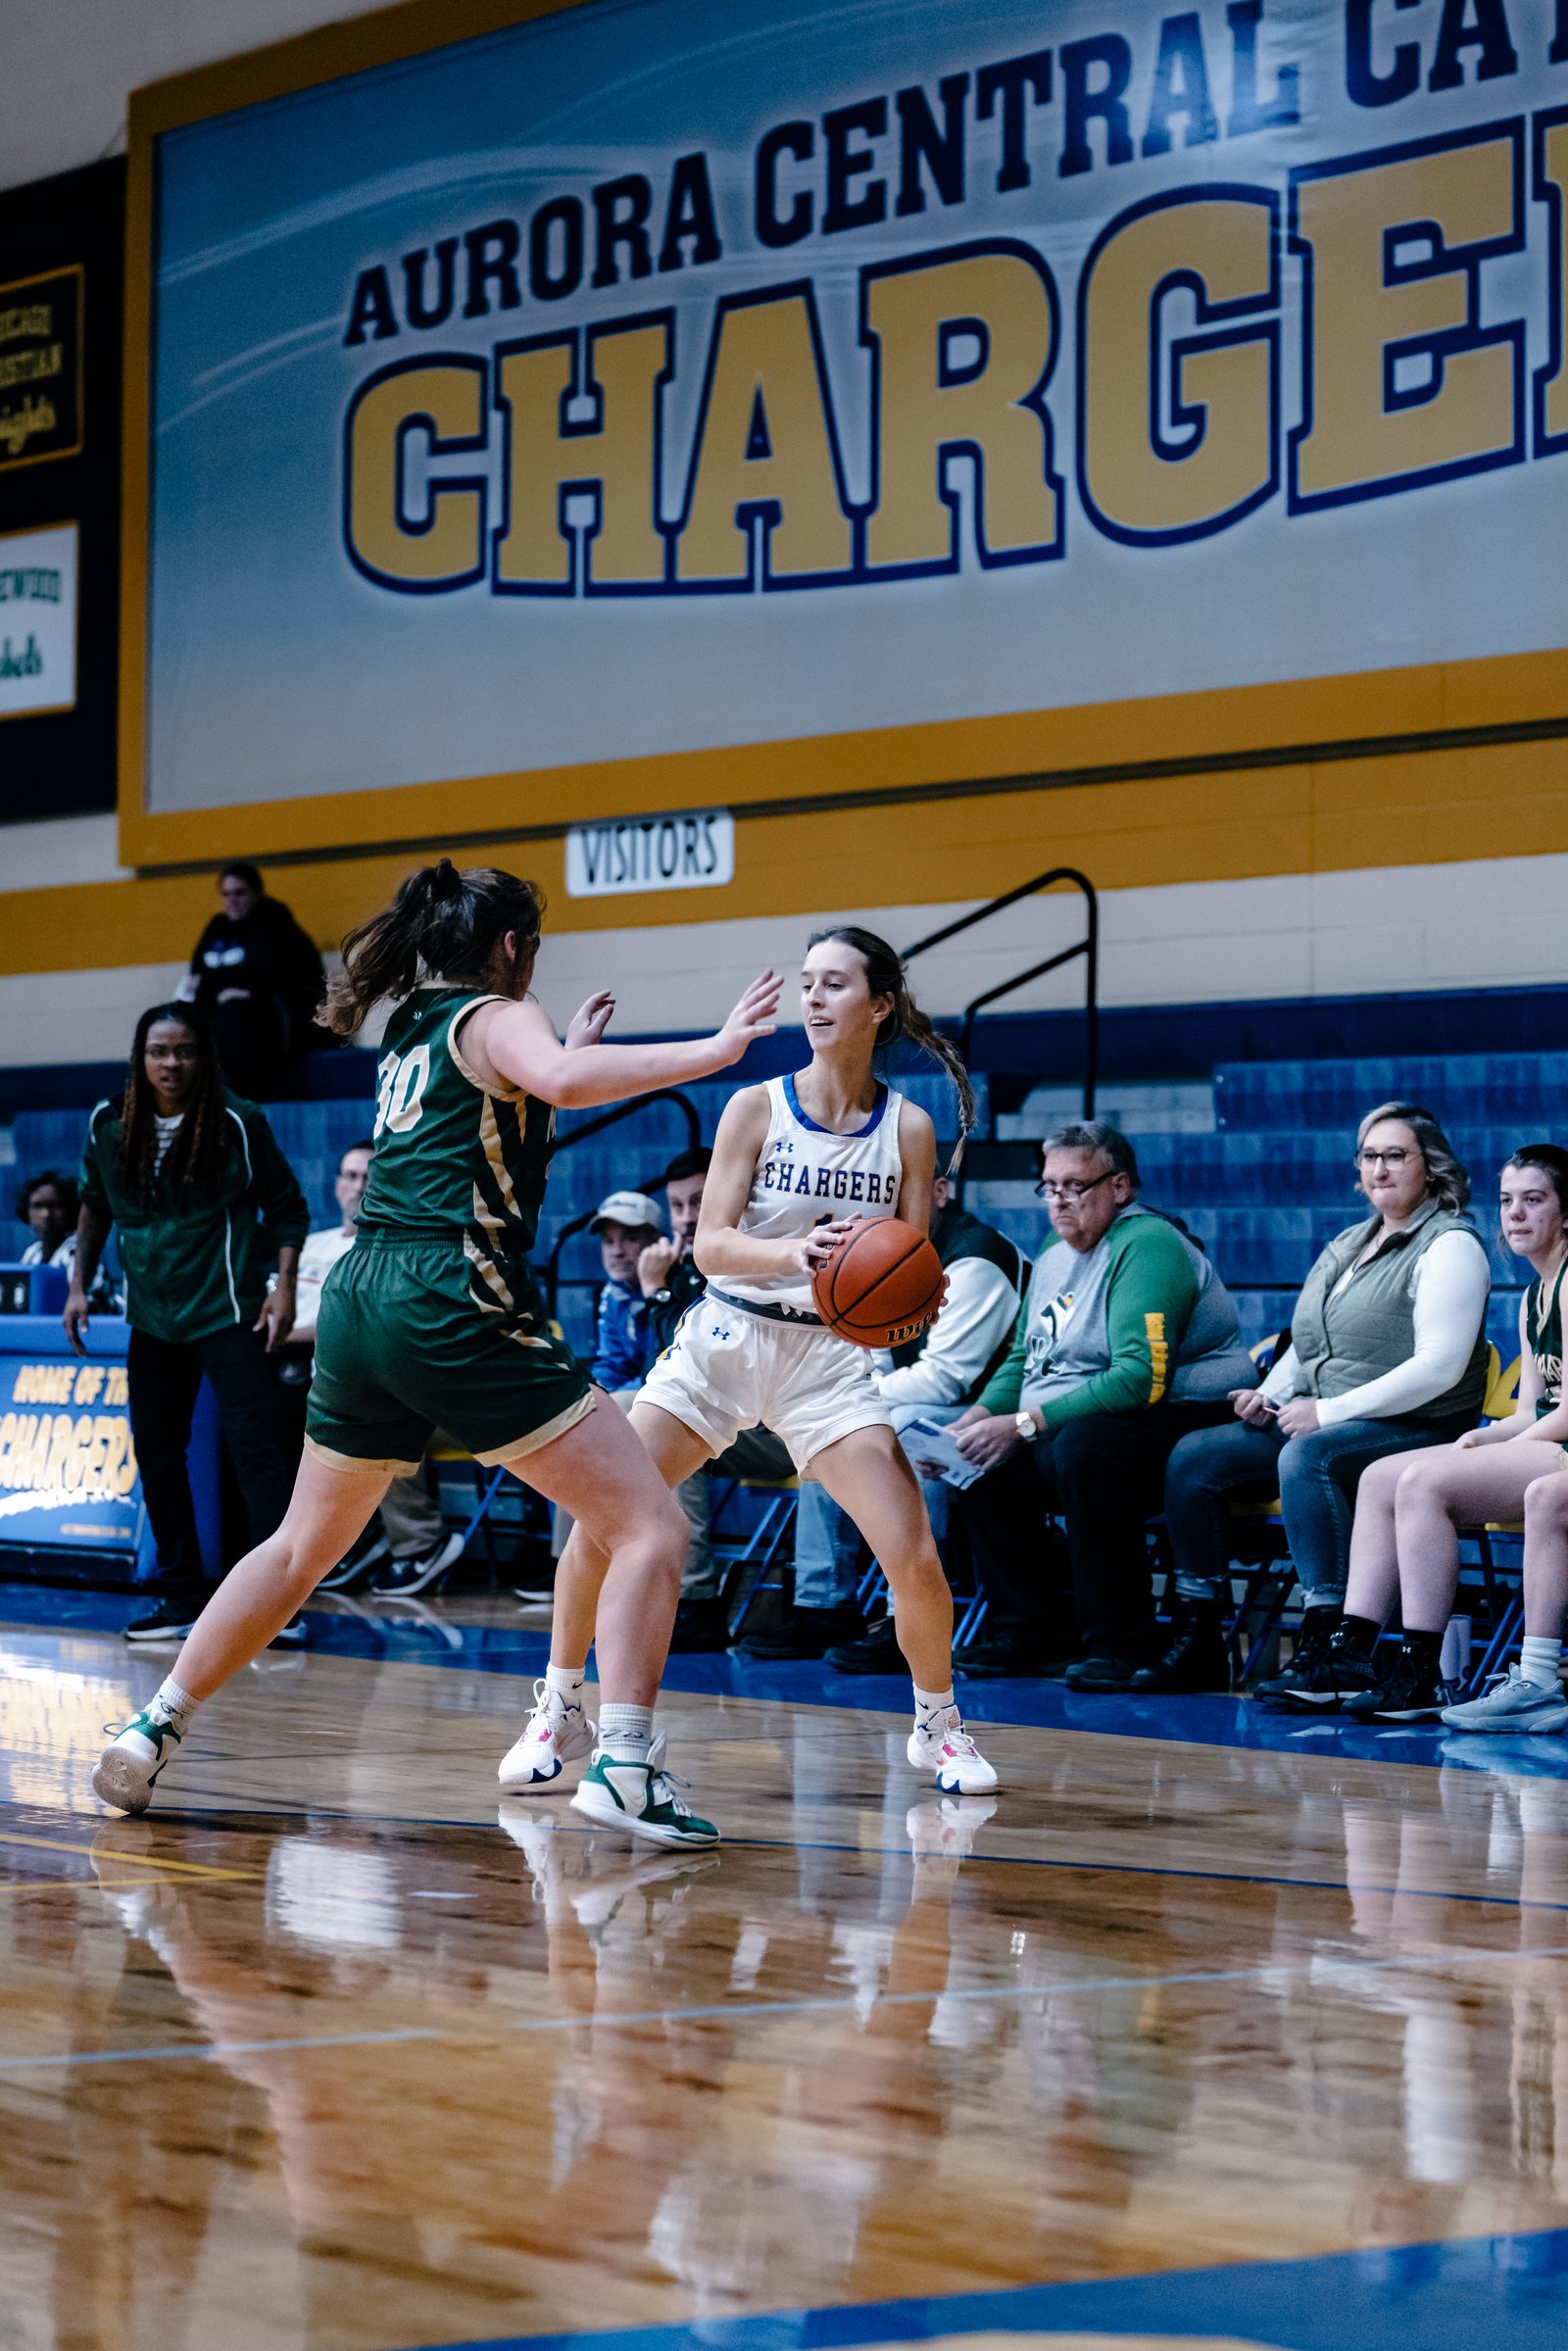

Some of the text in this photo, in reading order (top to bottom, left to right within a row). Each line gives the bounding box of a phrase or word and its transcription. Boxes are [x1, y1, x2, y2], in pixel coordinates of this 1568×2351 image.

[342, 0, 1568, 348] AURORA CENTRAL CA
[343, 104, 1568, 600] CHARGE
[579, 815, 717, 884] VISITORS
[373, 1044, 430, 1140] 30
[763, 1162, 896, 1204] CHARGERS
[13, 1365, 129, 1406] HOME OF TH
